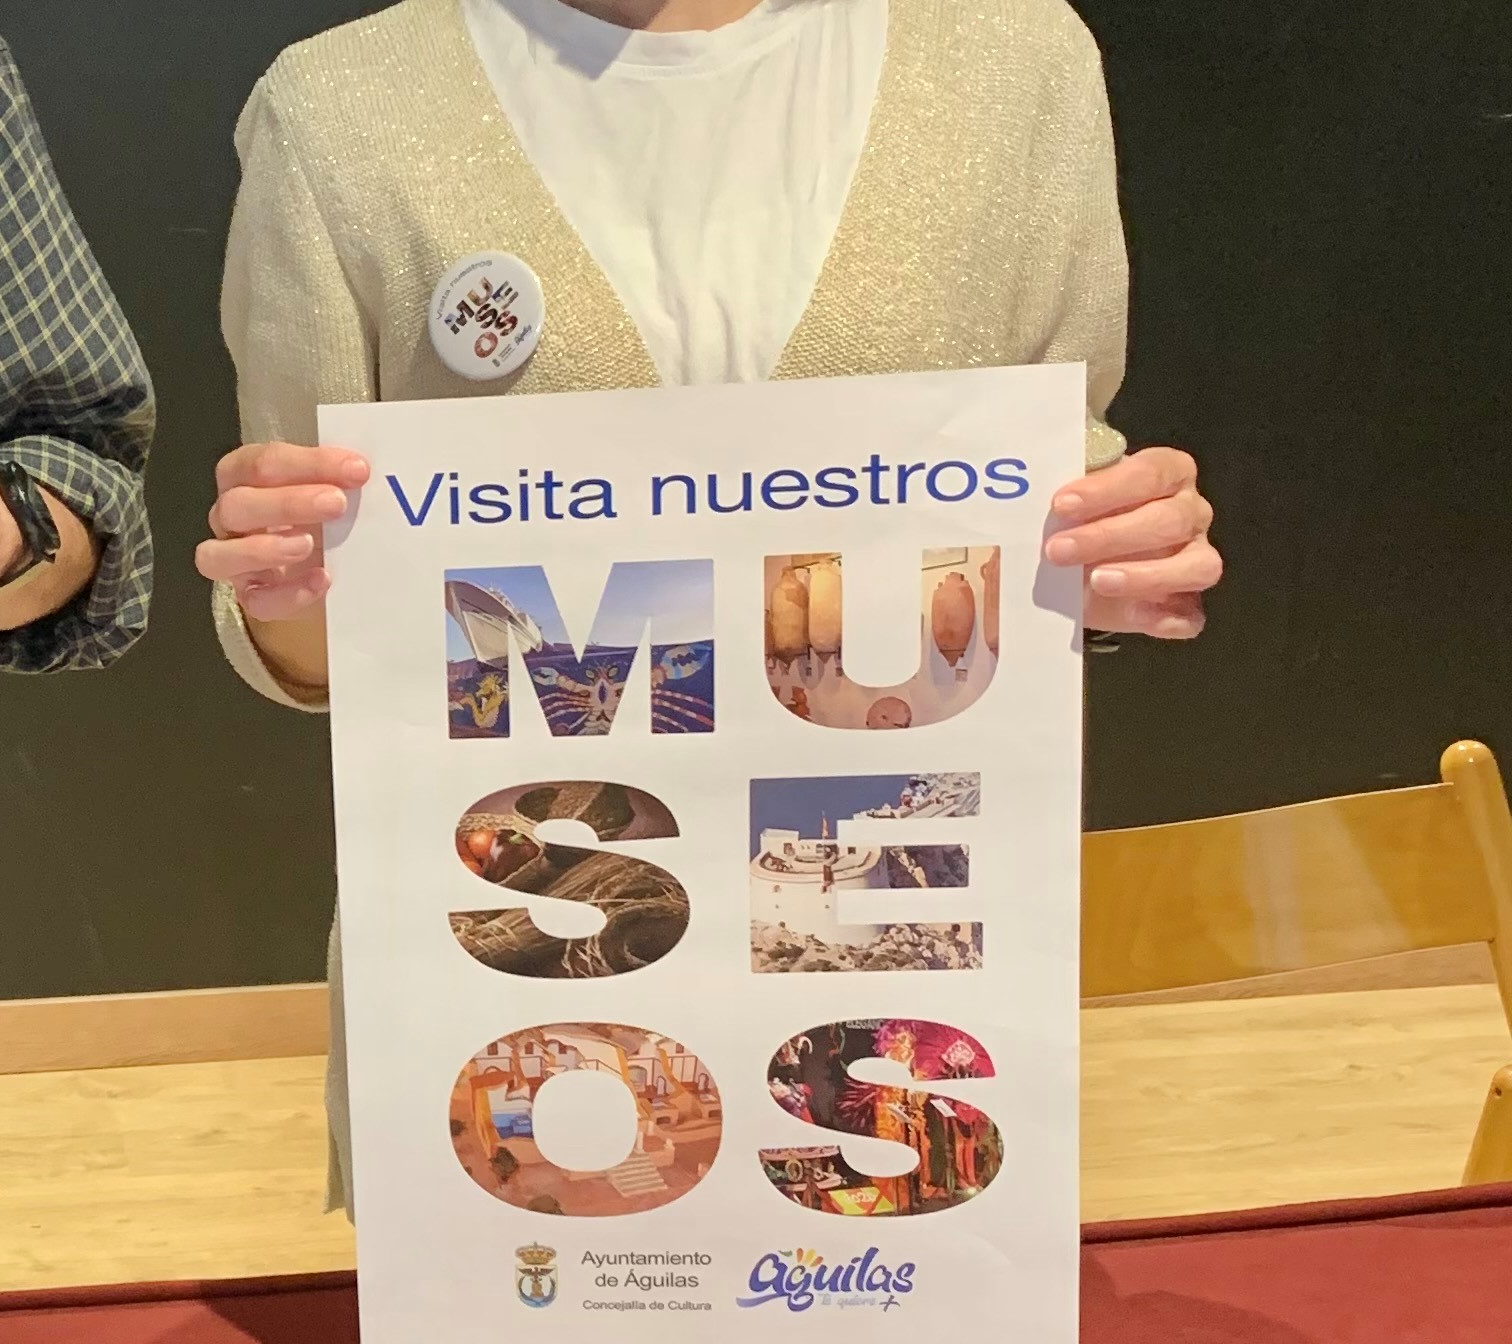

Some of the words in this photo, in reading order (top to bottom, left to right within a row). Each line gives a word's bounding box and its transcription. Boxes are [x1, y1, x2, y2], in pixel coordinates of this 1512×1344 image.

[385, 468, 618, 527] Visita
[651, 454, 1030, 516] nuestros
[581, 1251, 712, 1268] Ayuntamiento
[595, 1273, 619, 1288] de
[623, 1268, 700, 1291] Águilas
[649, 1301, 665, 1310] de
[668, 1300, 712, 1311] Cultura
